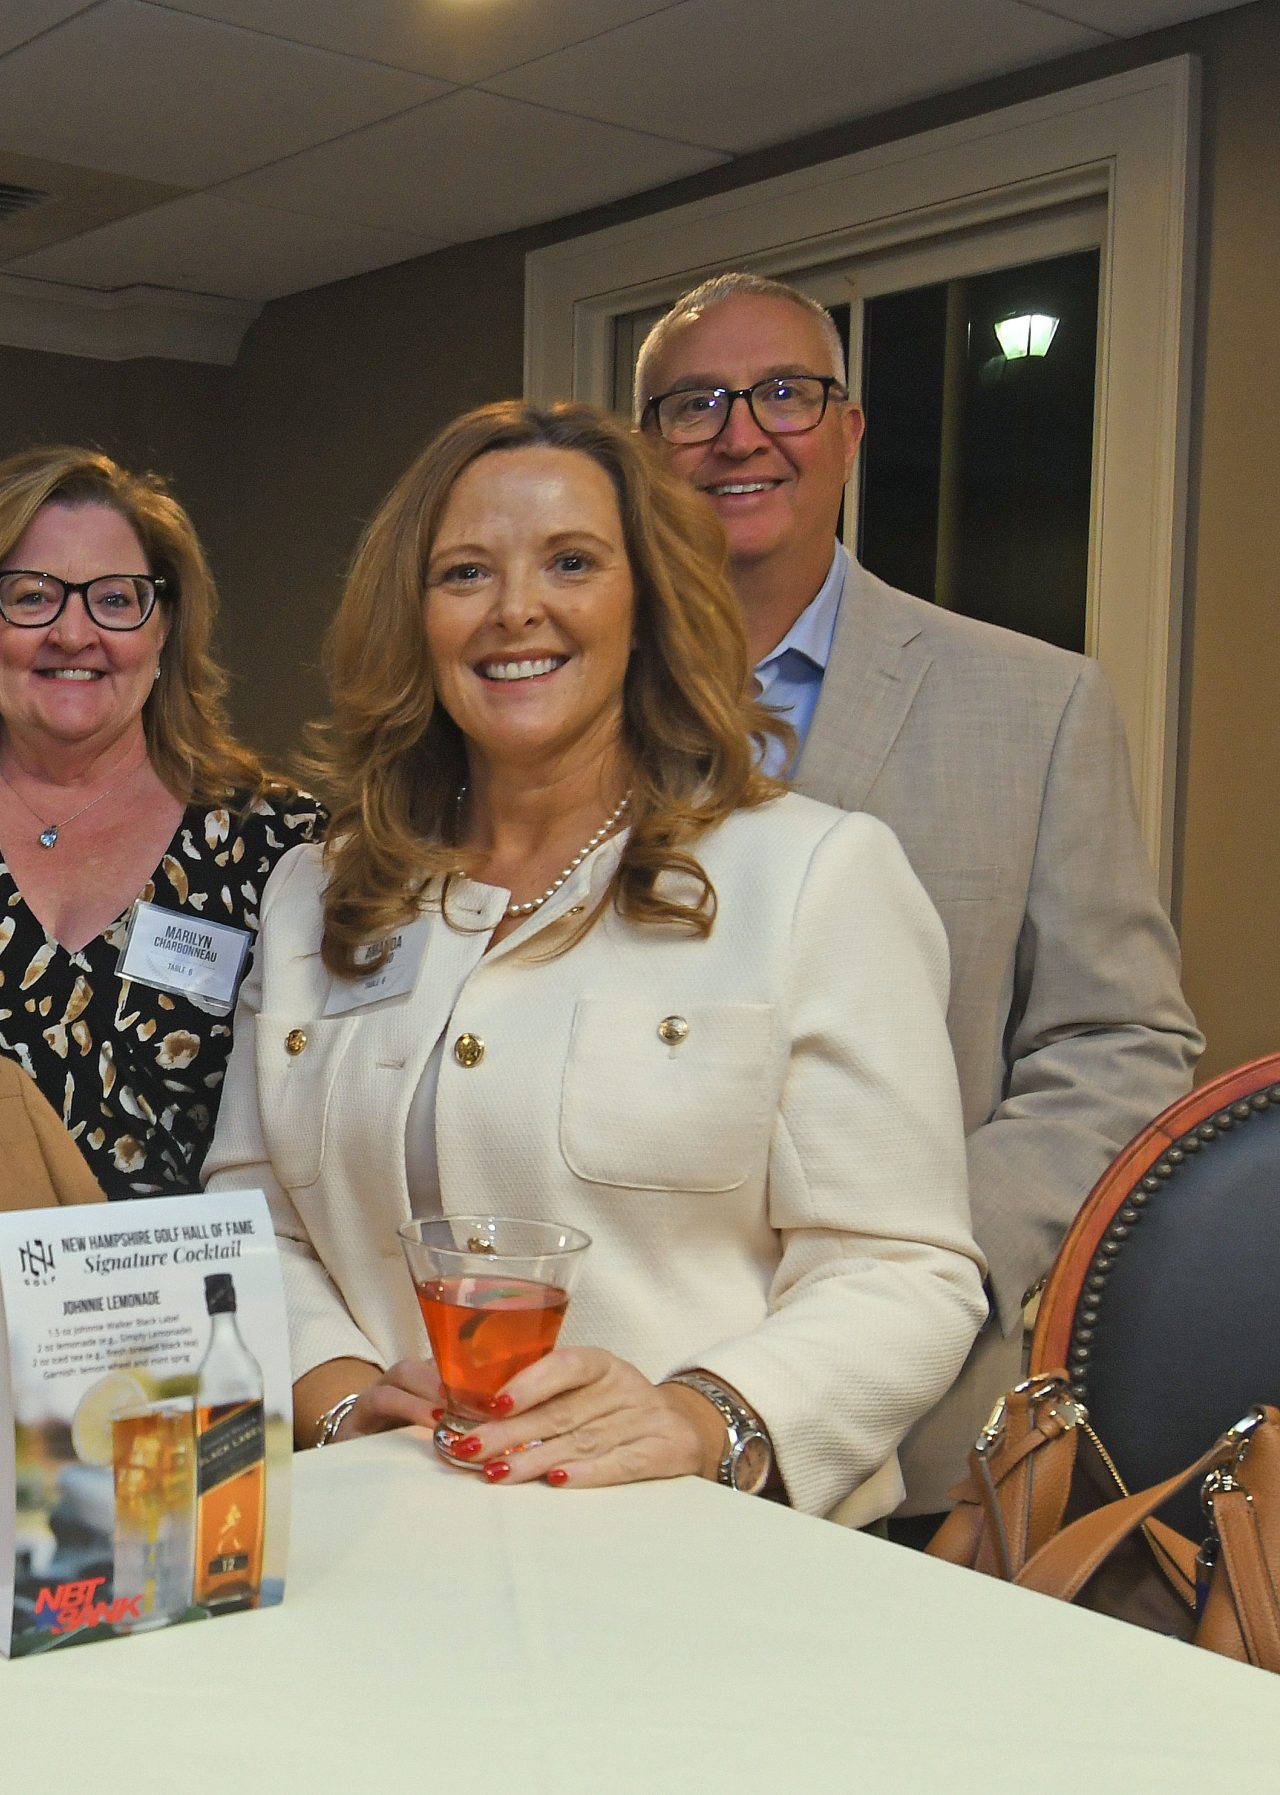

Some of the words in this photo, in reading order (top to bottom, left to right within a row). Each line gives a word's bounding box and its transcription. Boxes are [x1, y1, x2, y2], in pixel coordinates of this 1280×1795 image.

[154, 936, 218, 963] CHARBONNEAU
[165, 925, 213, 949] MARILYN
[61, 1237, 87, 1253] NEW
[88, 1230, 153, 1250] HAMPSHIRE
[154, 1227, 179, 1244] GOLF
[181, 1224, 210, 1241] HALL
[211, 1222, 223, 1238] OF
[226, 1219, 256, 1236] FAME
[83, 1251, 169, 1276] Signature
[173, 1240, 242, 1264] Cocktail
[63, 1296, 104, 1316] JOHNNIE
[106, 1290, 162, 1311] LEMONADE
[35, 1576, 106, 1615] NBT
